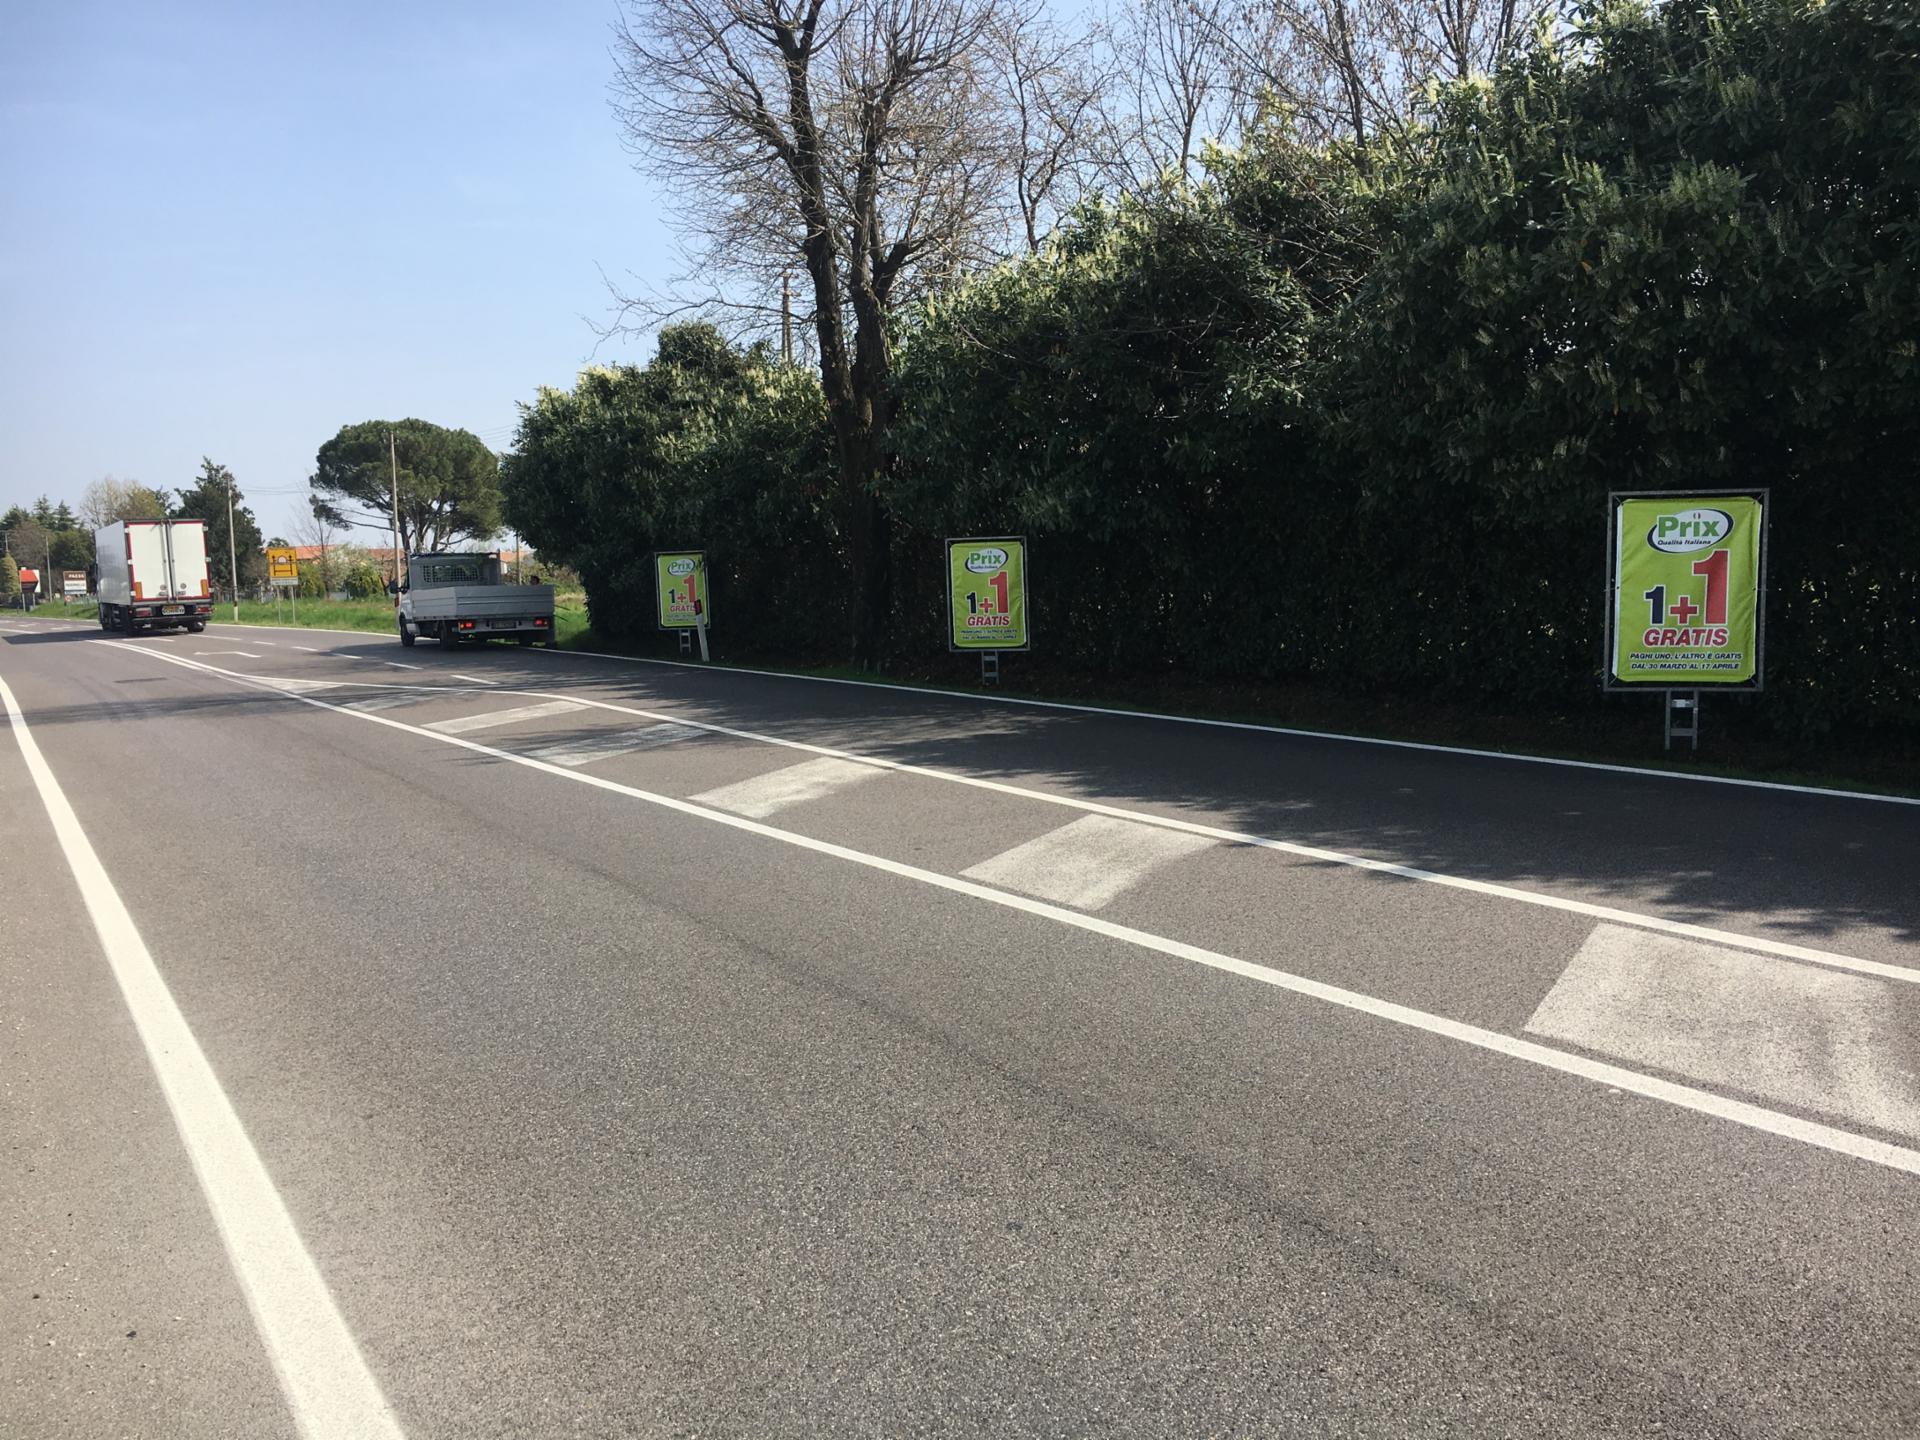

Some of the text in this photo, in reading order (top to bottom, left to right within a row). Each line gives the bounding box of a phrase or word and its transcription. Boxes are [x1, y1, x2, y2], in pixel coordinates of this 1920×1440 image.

[1658, 512, 1720, 537] Prix
[970, 550, 1002, 564] Prix
[671, 560, 691, 570] Prix
[670, 604, 696, 613] GRATI
[967, 615, 1010, 627] GRATIS
[1643, 628, 1728, 647] GRATIS
